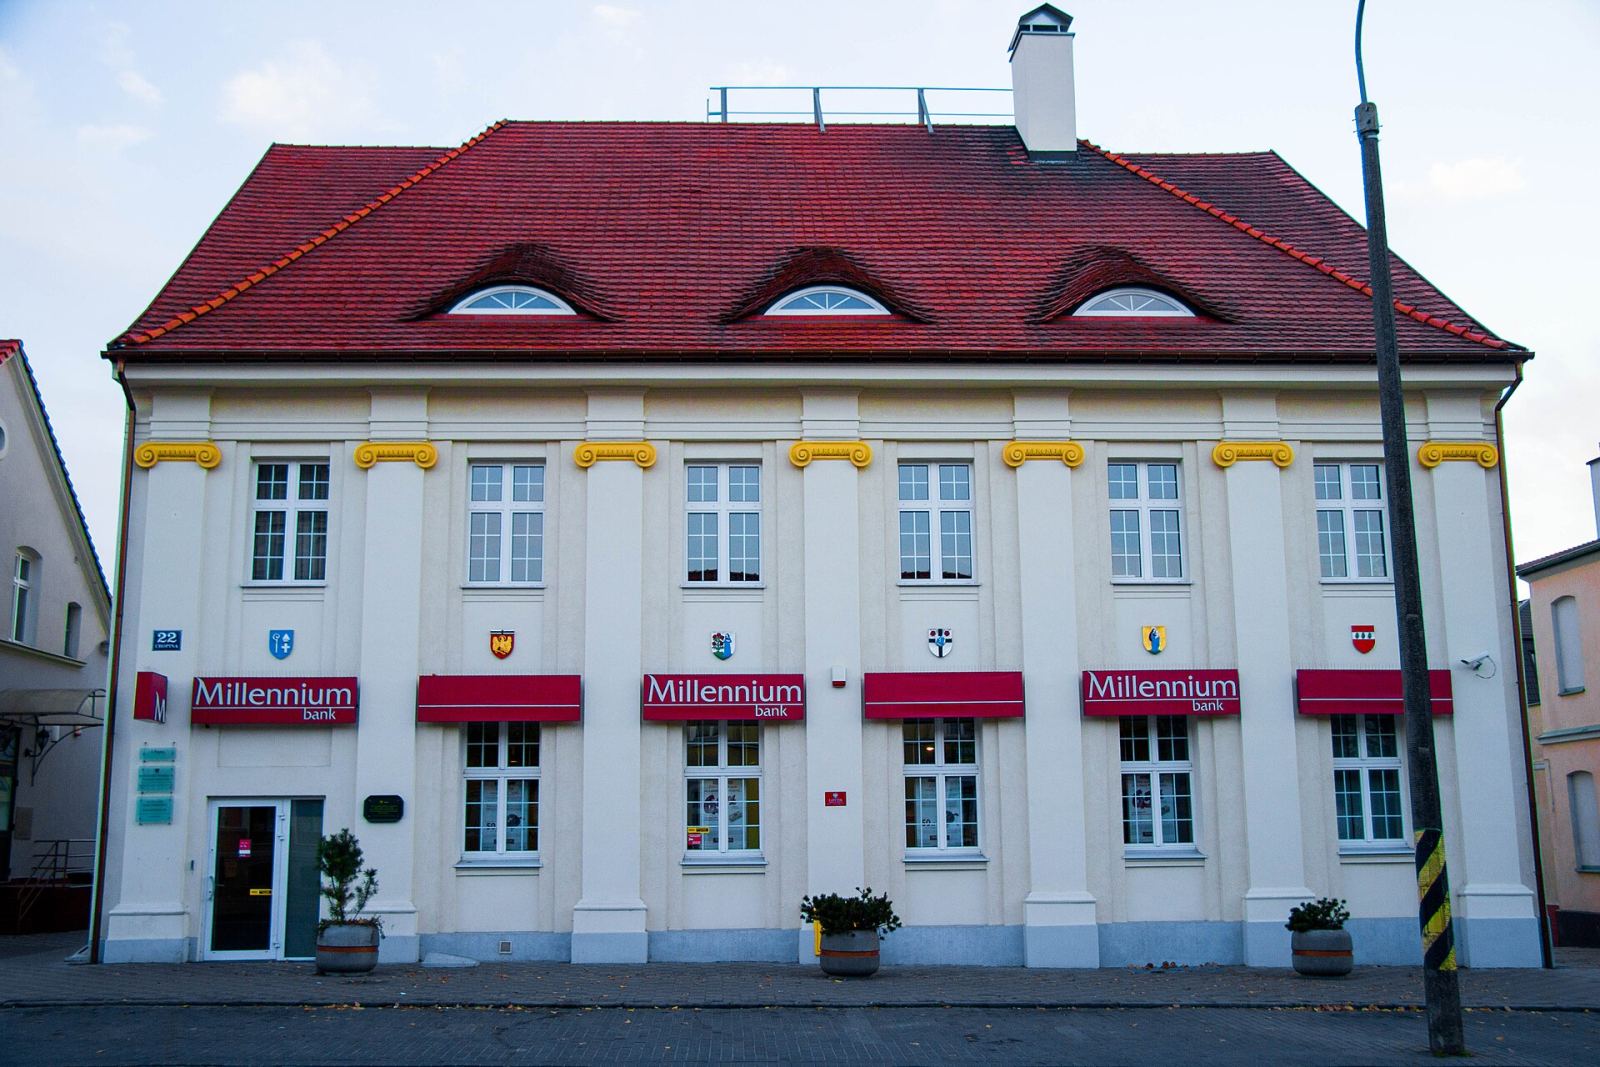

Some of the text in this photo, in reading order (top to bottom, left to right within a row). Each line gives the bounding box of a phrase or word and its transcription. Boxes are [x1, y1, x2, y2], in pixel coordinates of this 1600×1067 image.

[157, 632, 177, 643] 22
[195, 677, 351, 705] Millennium
[648, 674, 801, 702] Millennium
[1088, 671, 1236, 698] Millennium
[154, 690, 166, 723] M
[303, 708, 336, 720] bank
[755, 705, 788, 717] bank
[1192, 700, 1224, 711] bank
